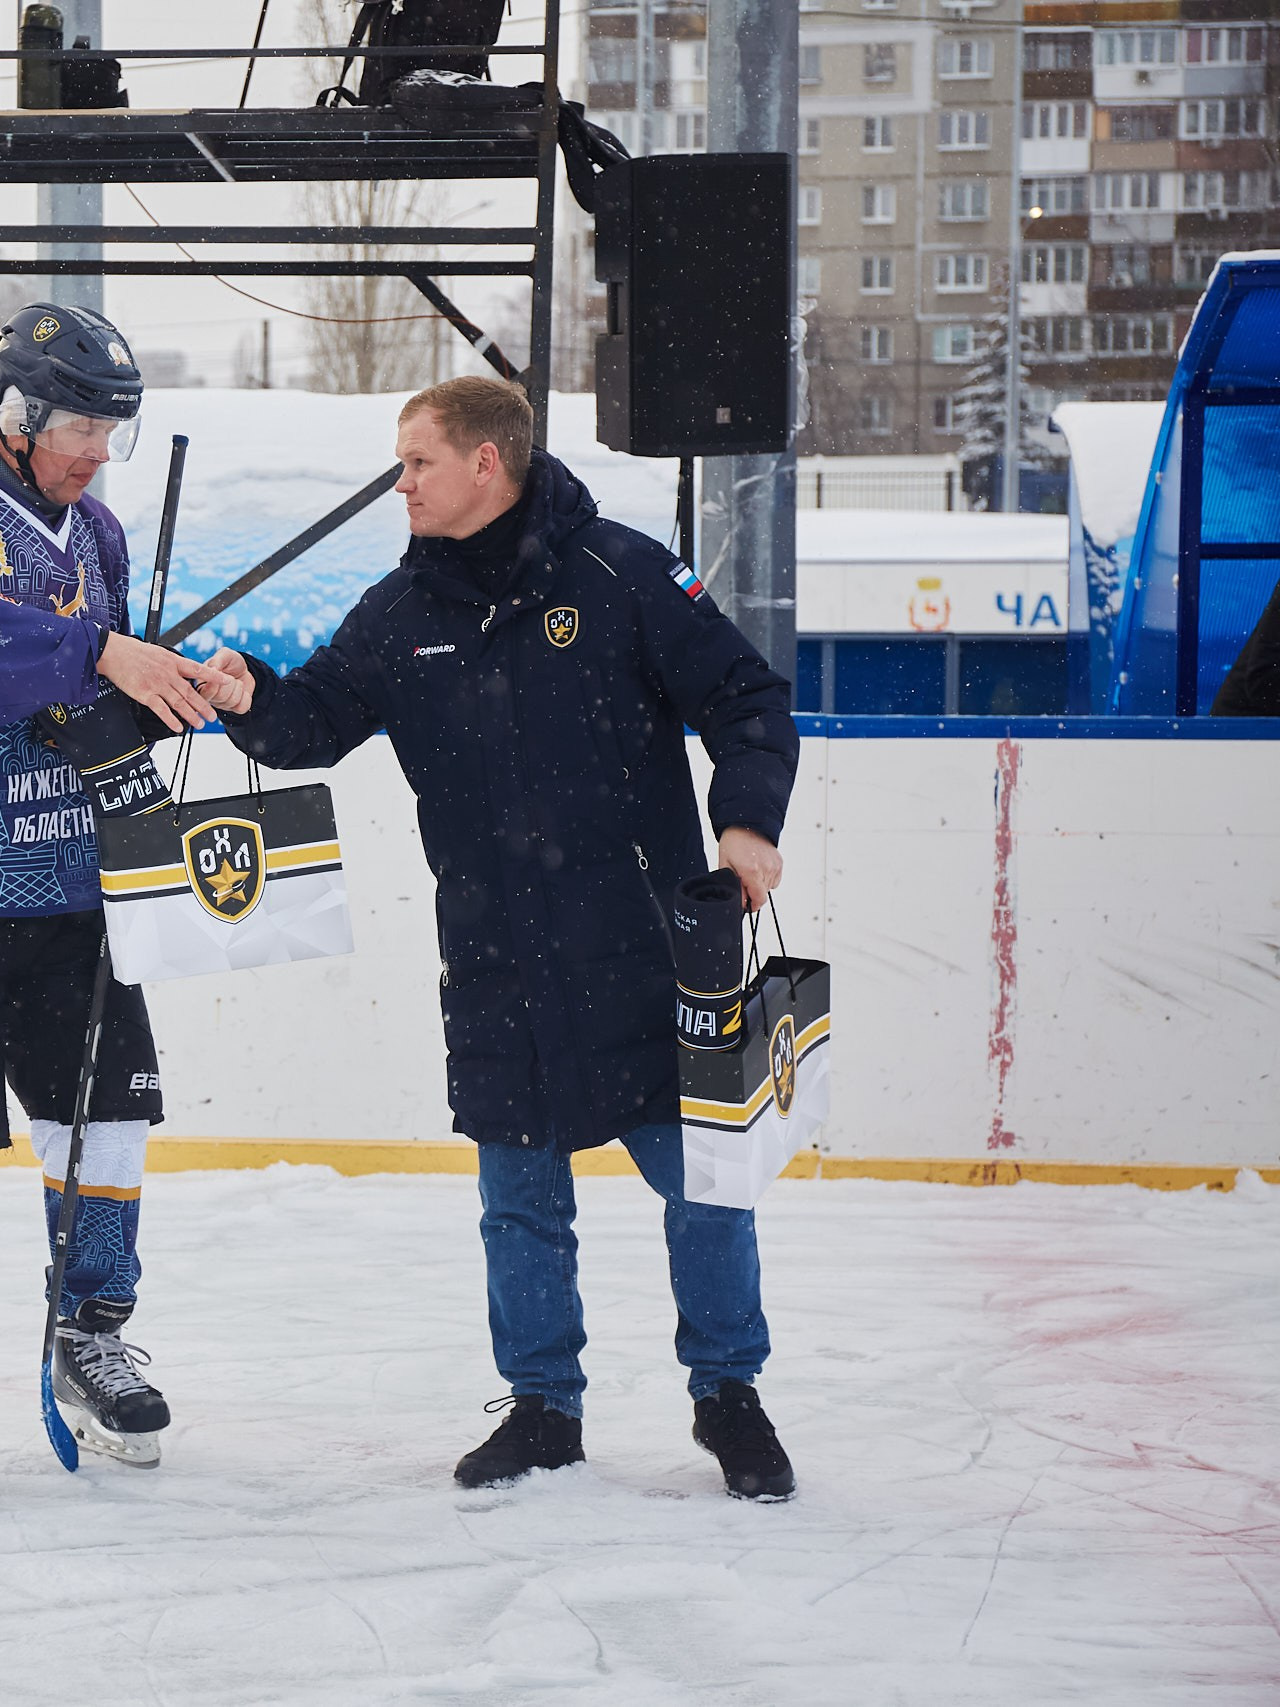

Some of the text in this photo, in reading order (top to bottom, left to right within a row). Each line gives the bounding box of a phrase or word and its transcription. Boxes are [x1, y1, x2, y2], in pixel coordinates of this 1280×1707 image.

[995, 593, 1061, 628] ЧА
[413, 644, 456, 657] FORWARD
[71, 704, 95, 719] ЛИГА
[11, 804, 96, 844] ОБЛАСТН
[199, 828, 251, 874] ОХЛ
